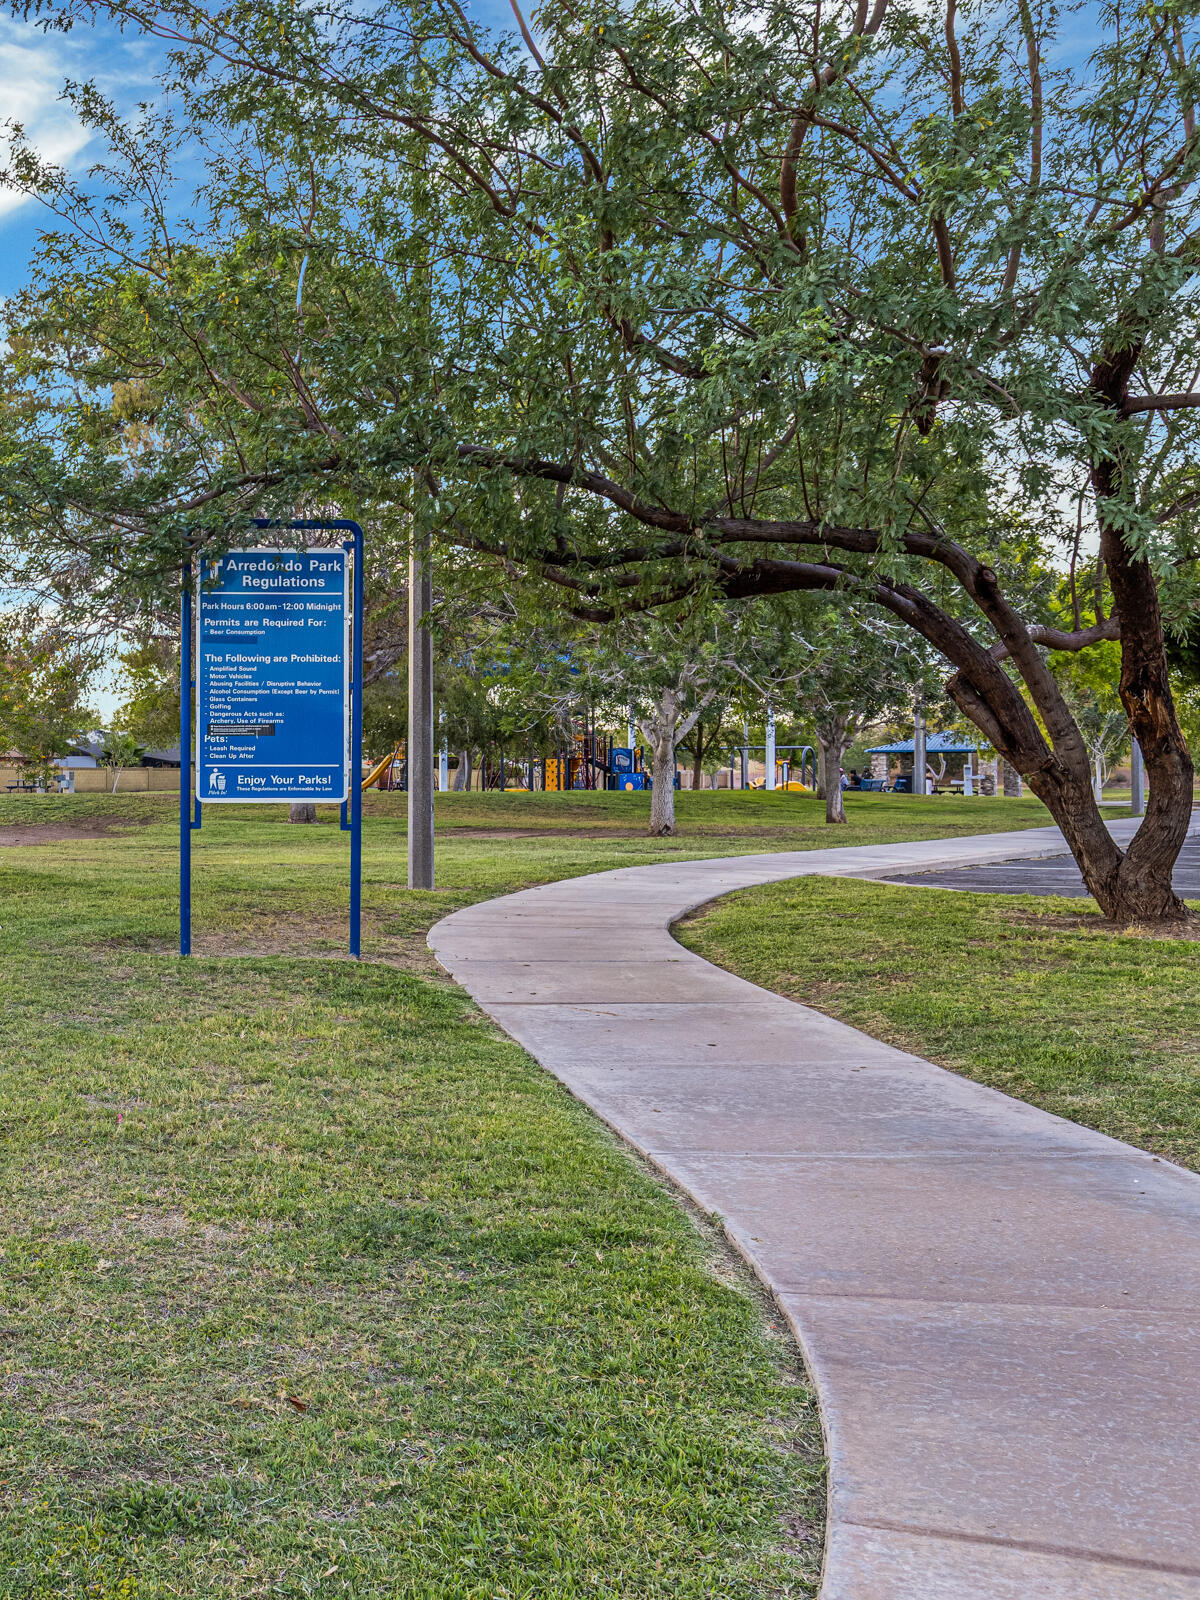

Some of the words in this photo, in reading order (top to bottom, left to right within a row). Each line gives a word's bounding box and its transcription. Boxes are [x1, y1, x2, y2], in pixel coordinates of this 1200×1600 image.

[309, 559, 342, 572] Park
[242, 575, 326, 589] Regulations
[202, 602, 219, 610] Park
[221, 602, 244, 610] Hours
[282, 602, 304, 610] 12:00
[306, 602, 341, 612] Midnight
[204, 618, 240, 627] Permits
[262, 618, 305, 629] Required
[308, 618, 327, 627] For:
[204, 654, 223, 663] The
[225, 653, 271, 664] Following
[290, 654, 342, 663] Prohibited:
[204, 735, 228, 743] Pets:
[237, 775, 267, 787] Enjoy
[270, 775, 295, 784] Your
[298, 775, 332, 784] Parks!
